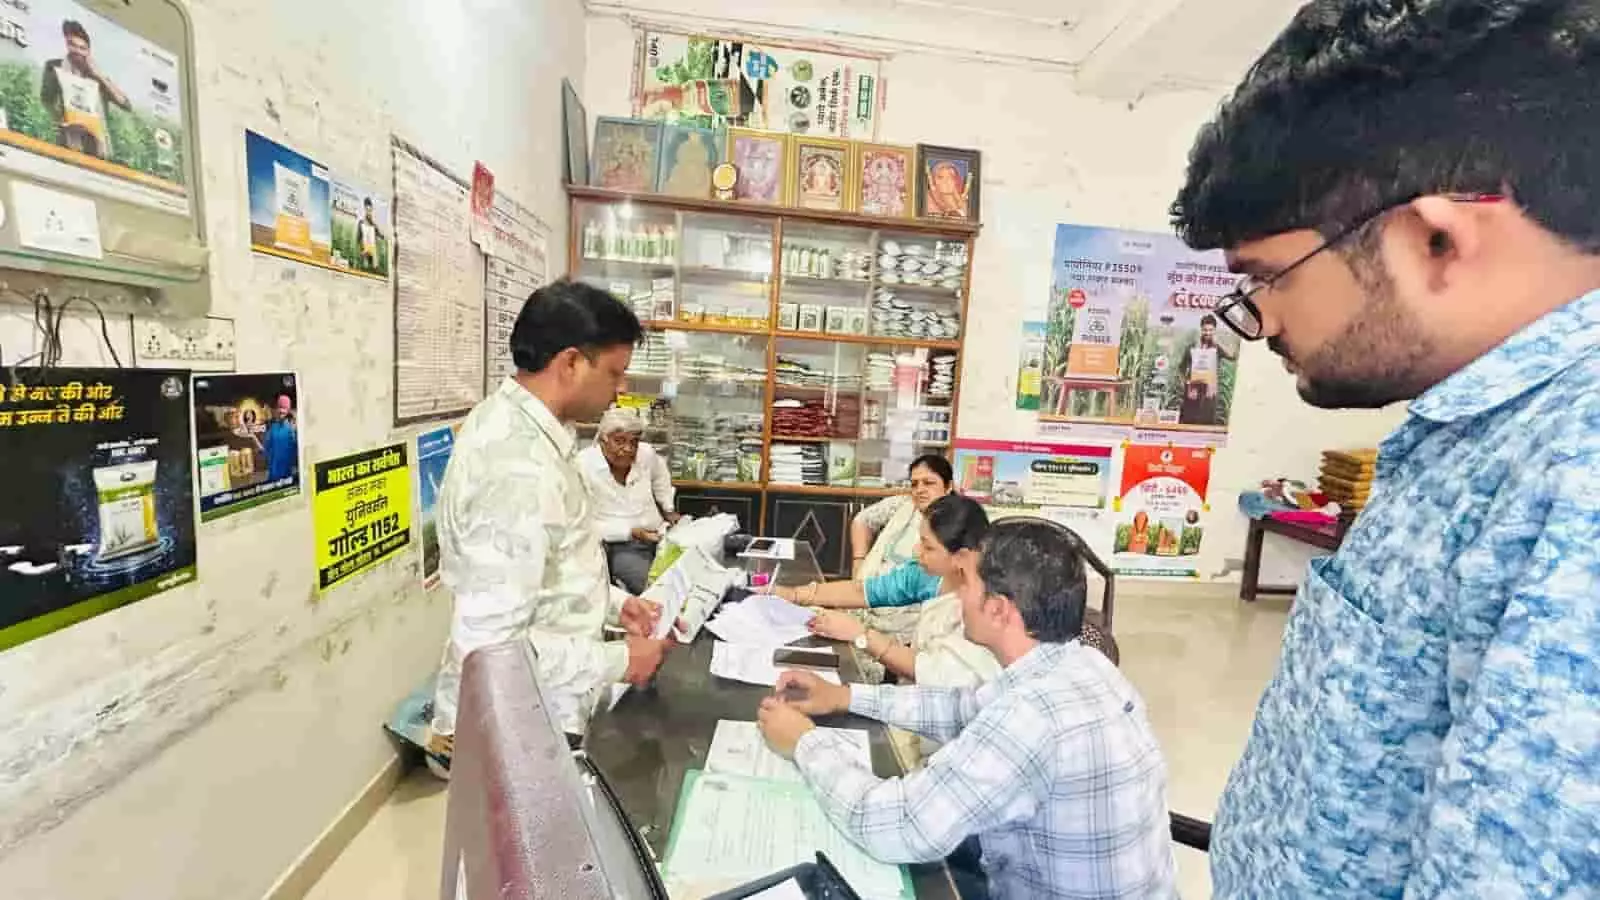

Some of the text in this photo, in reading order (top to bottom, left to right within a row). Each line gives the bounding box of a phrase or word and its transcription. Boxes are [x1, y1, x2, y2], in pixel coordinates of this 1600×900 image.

[60, 381, 82, 400] की
[72, 403, 96, 422] की
[328, 524, 369, 557] गोल्ड
[371, 512, 400, 541] 1152
